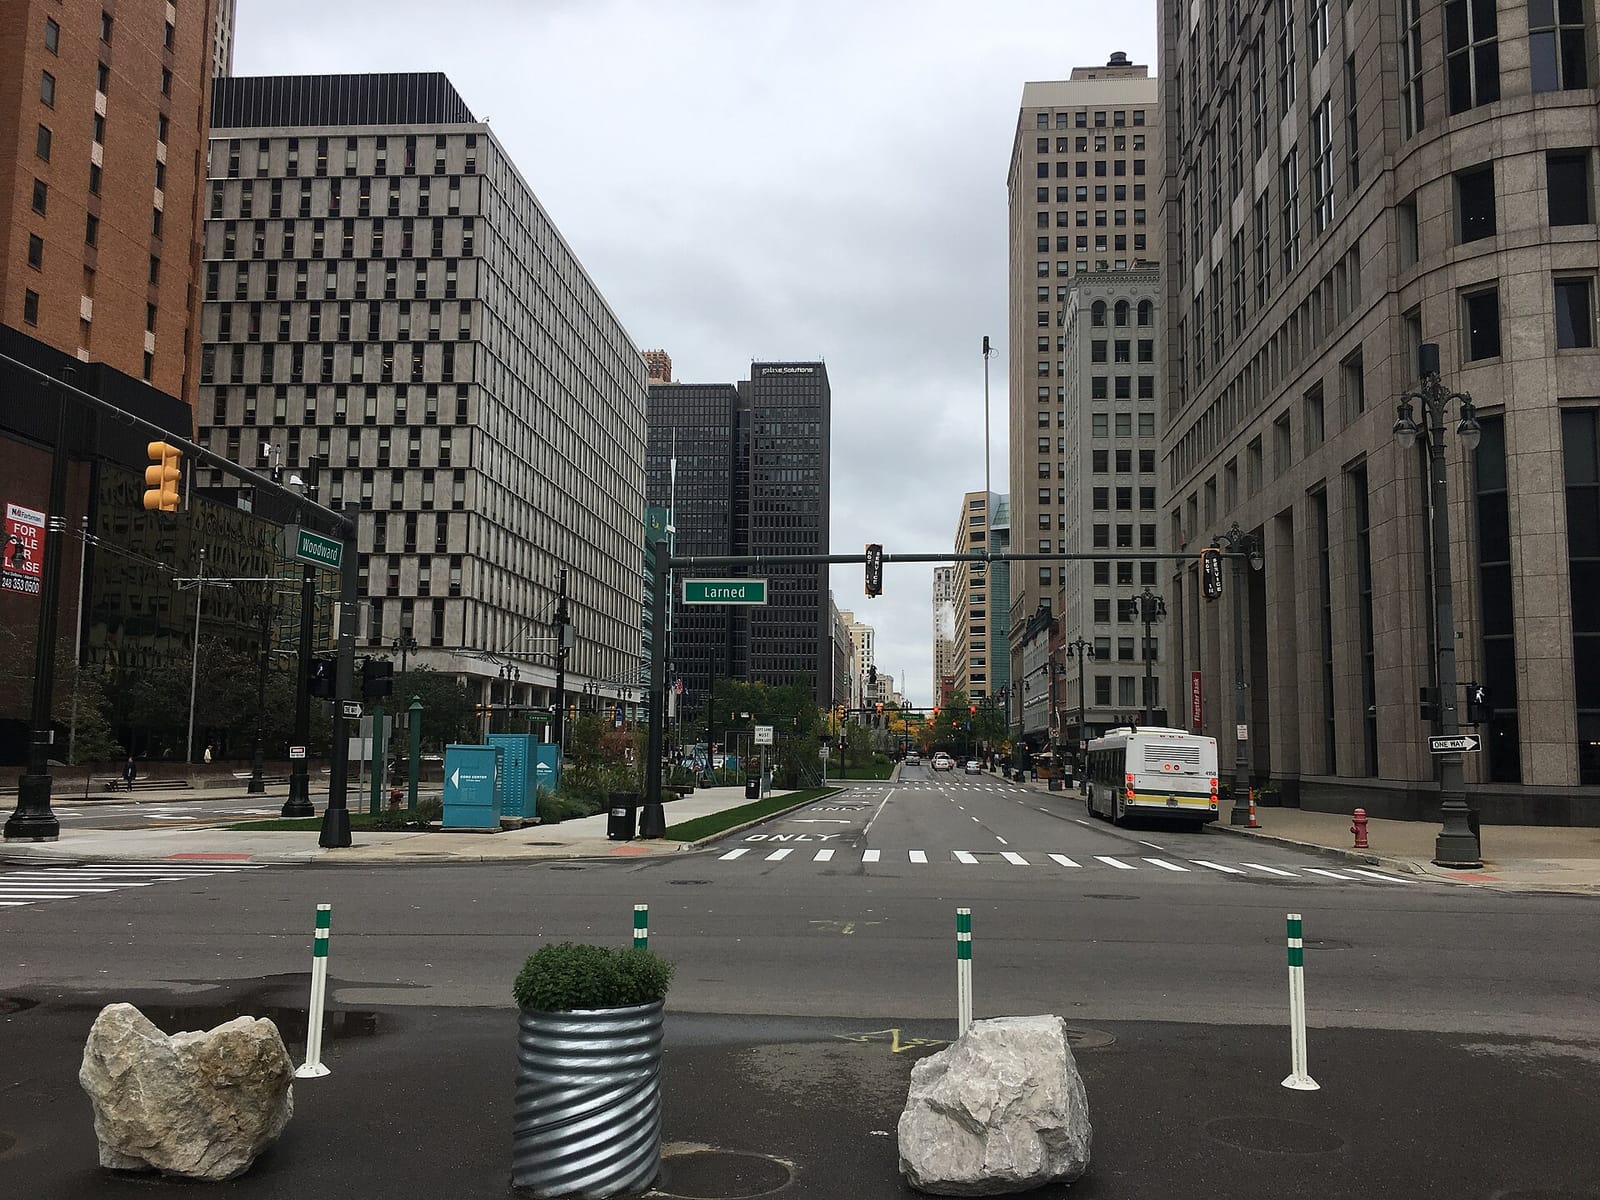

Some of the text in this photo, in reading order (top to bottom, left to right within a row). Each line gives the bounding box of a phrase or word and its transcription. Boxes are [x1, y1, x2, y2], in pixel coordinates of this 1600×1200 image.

[14, 523, 36, 538] FOR
[302, 537, 338, 560] Woodward
[872, 552, 880, 584] SERVICE
[1212, 558, 1222, 592] SERVICE
[12, 578, 24, 591] 353
[704, 586, 745, 598] Larned
